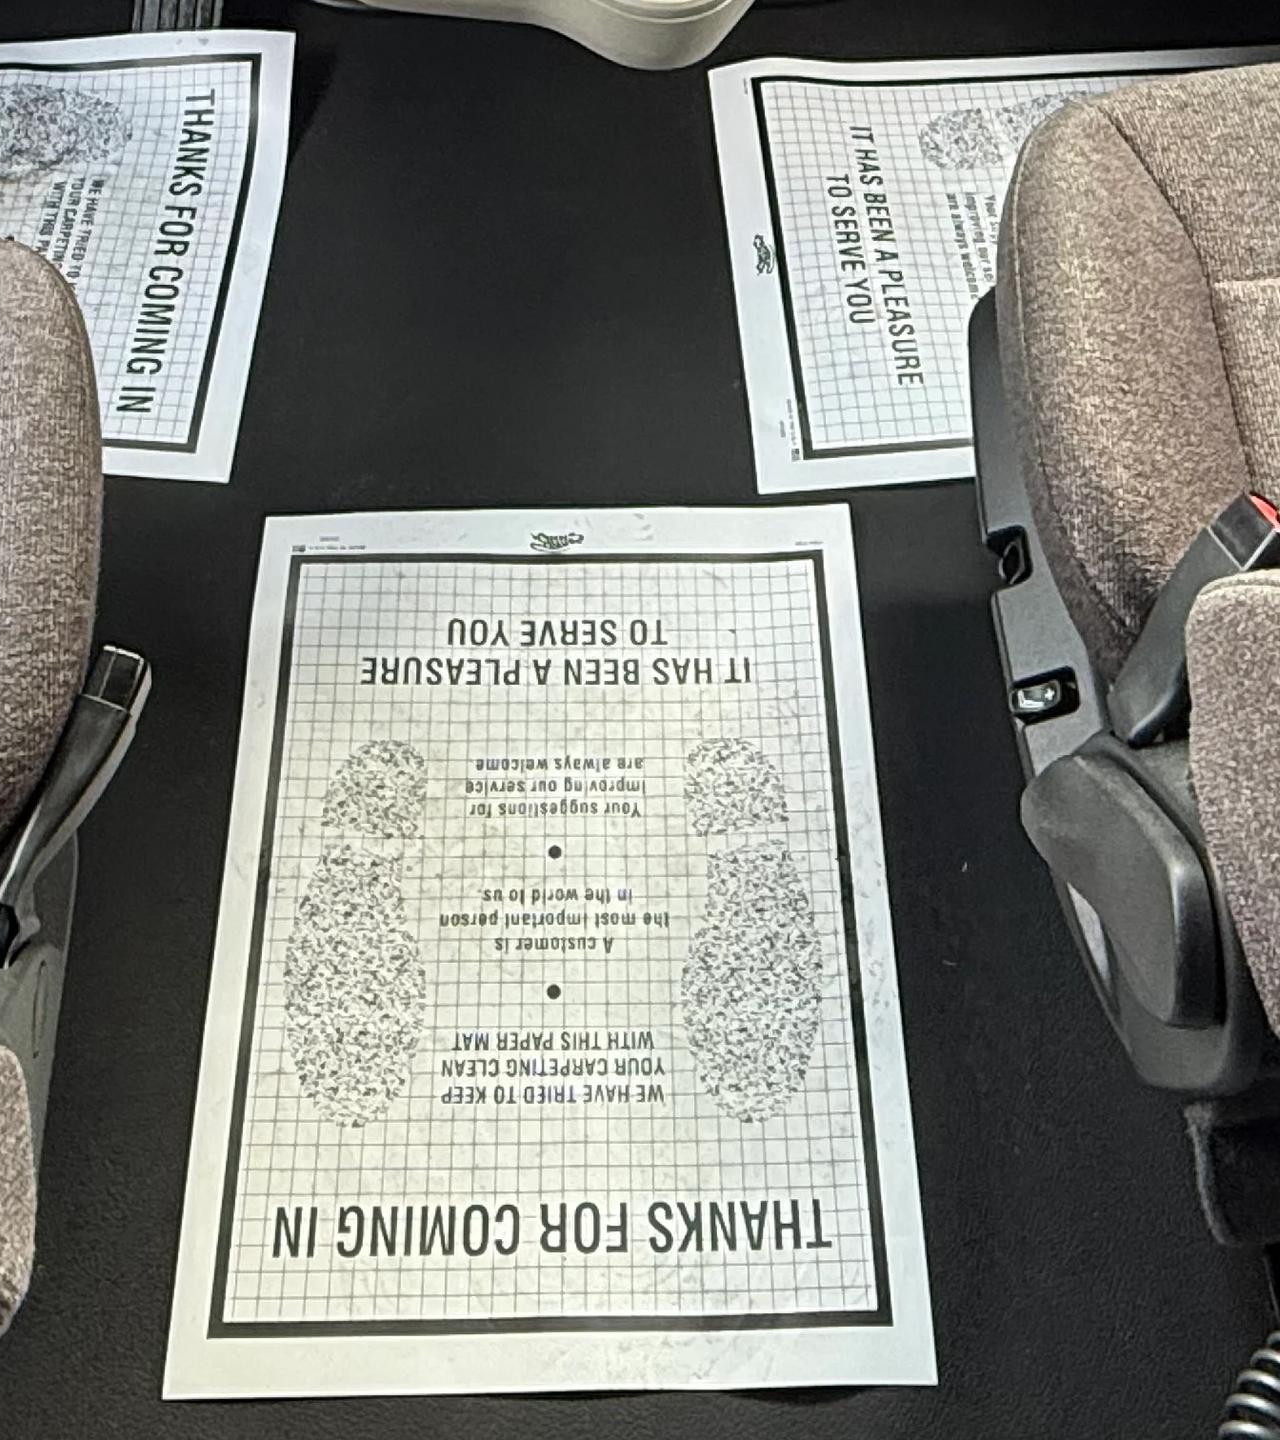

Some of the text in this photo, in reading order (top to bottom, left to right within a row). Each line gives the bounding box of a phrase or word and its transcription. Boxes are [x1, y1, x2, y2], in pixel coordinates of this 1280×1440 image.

[46, 181, 67, 210] WITH
[65, 179, 105, 278] WE HAVE TRIED TO
[116, 88, 216, 413] THANKS FOR COMING IN
[825, 173, 876, 325] TO SERVE YOU
[849, 126, 924, 386] IT HAS BEEN A PLEASURE
[447, 617, 669, 647] TO SERVE YOU
[359, 656, 751, 686] IT HAS BEEN A PLEASURE
[475, 755, 644, 773] are always welcome
[465, 777, 646, 795] improving our service
[470, 798, 642, 818] Your suggestions for
[508, 888, 526, 905] to
[531, 888, 579, 905] world
[584, 888, 612, 905] the
[617, 888, 632, 905] in
[439, 909, 670, 929] the most important person
[495, 936, 615, 955] A customer is
[451, 1030, 655, 1051] WITH THIS PAPER MAT
[441, 1057, 666, 1078] YOUR CARPETING CLEAN
[440, 1083, 667, 1105] WE HAVE TRIED TO KEEP
[272, 1197, 834, 1259] THANKS FOR COMING IN
